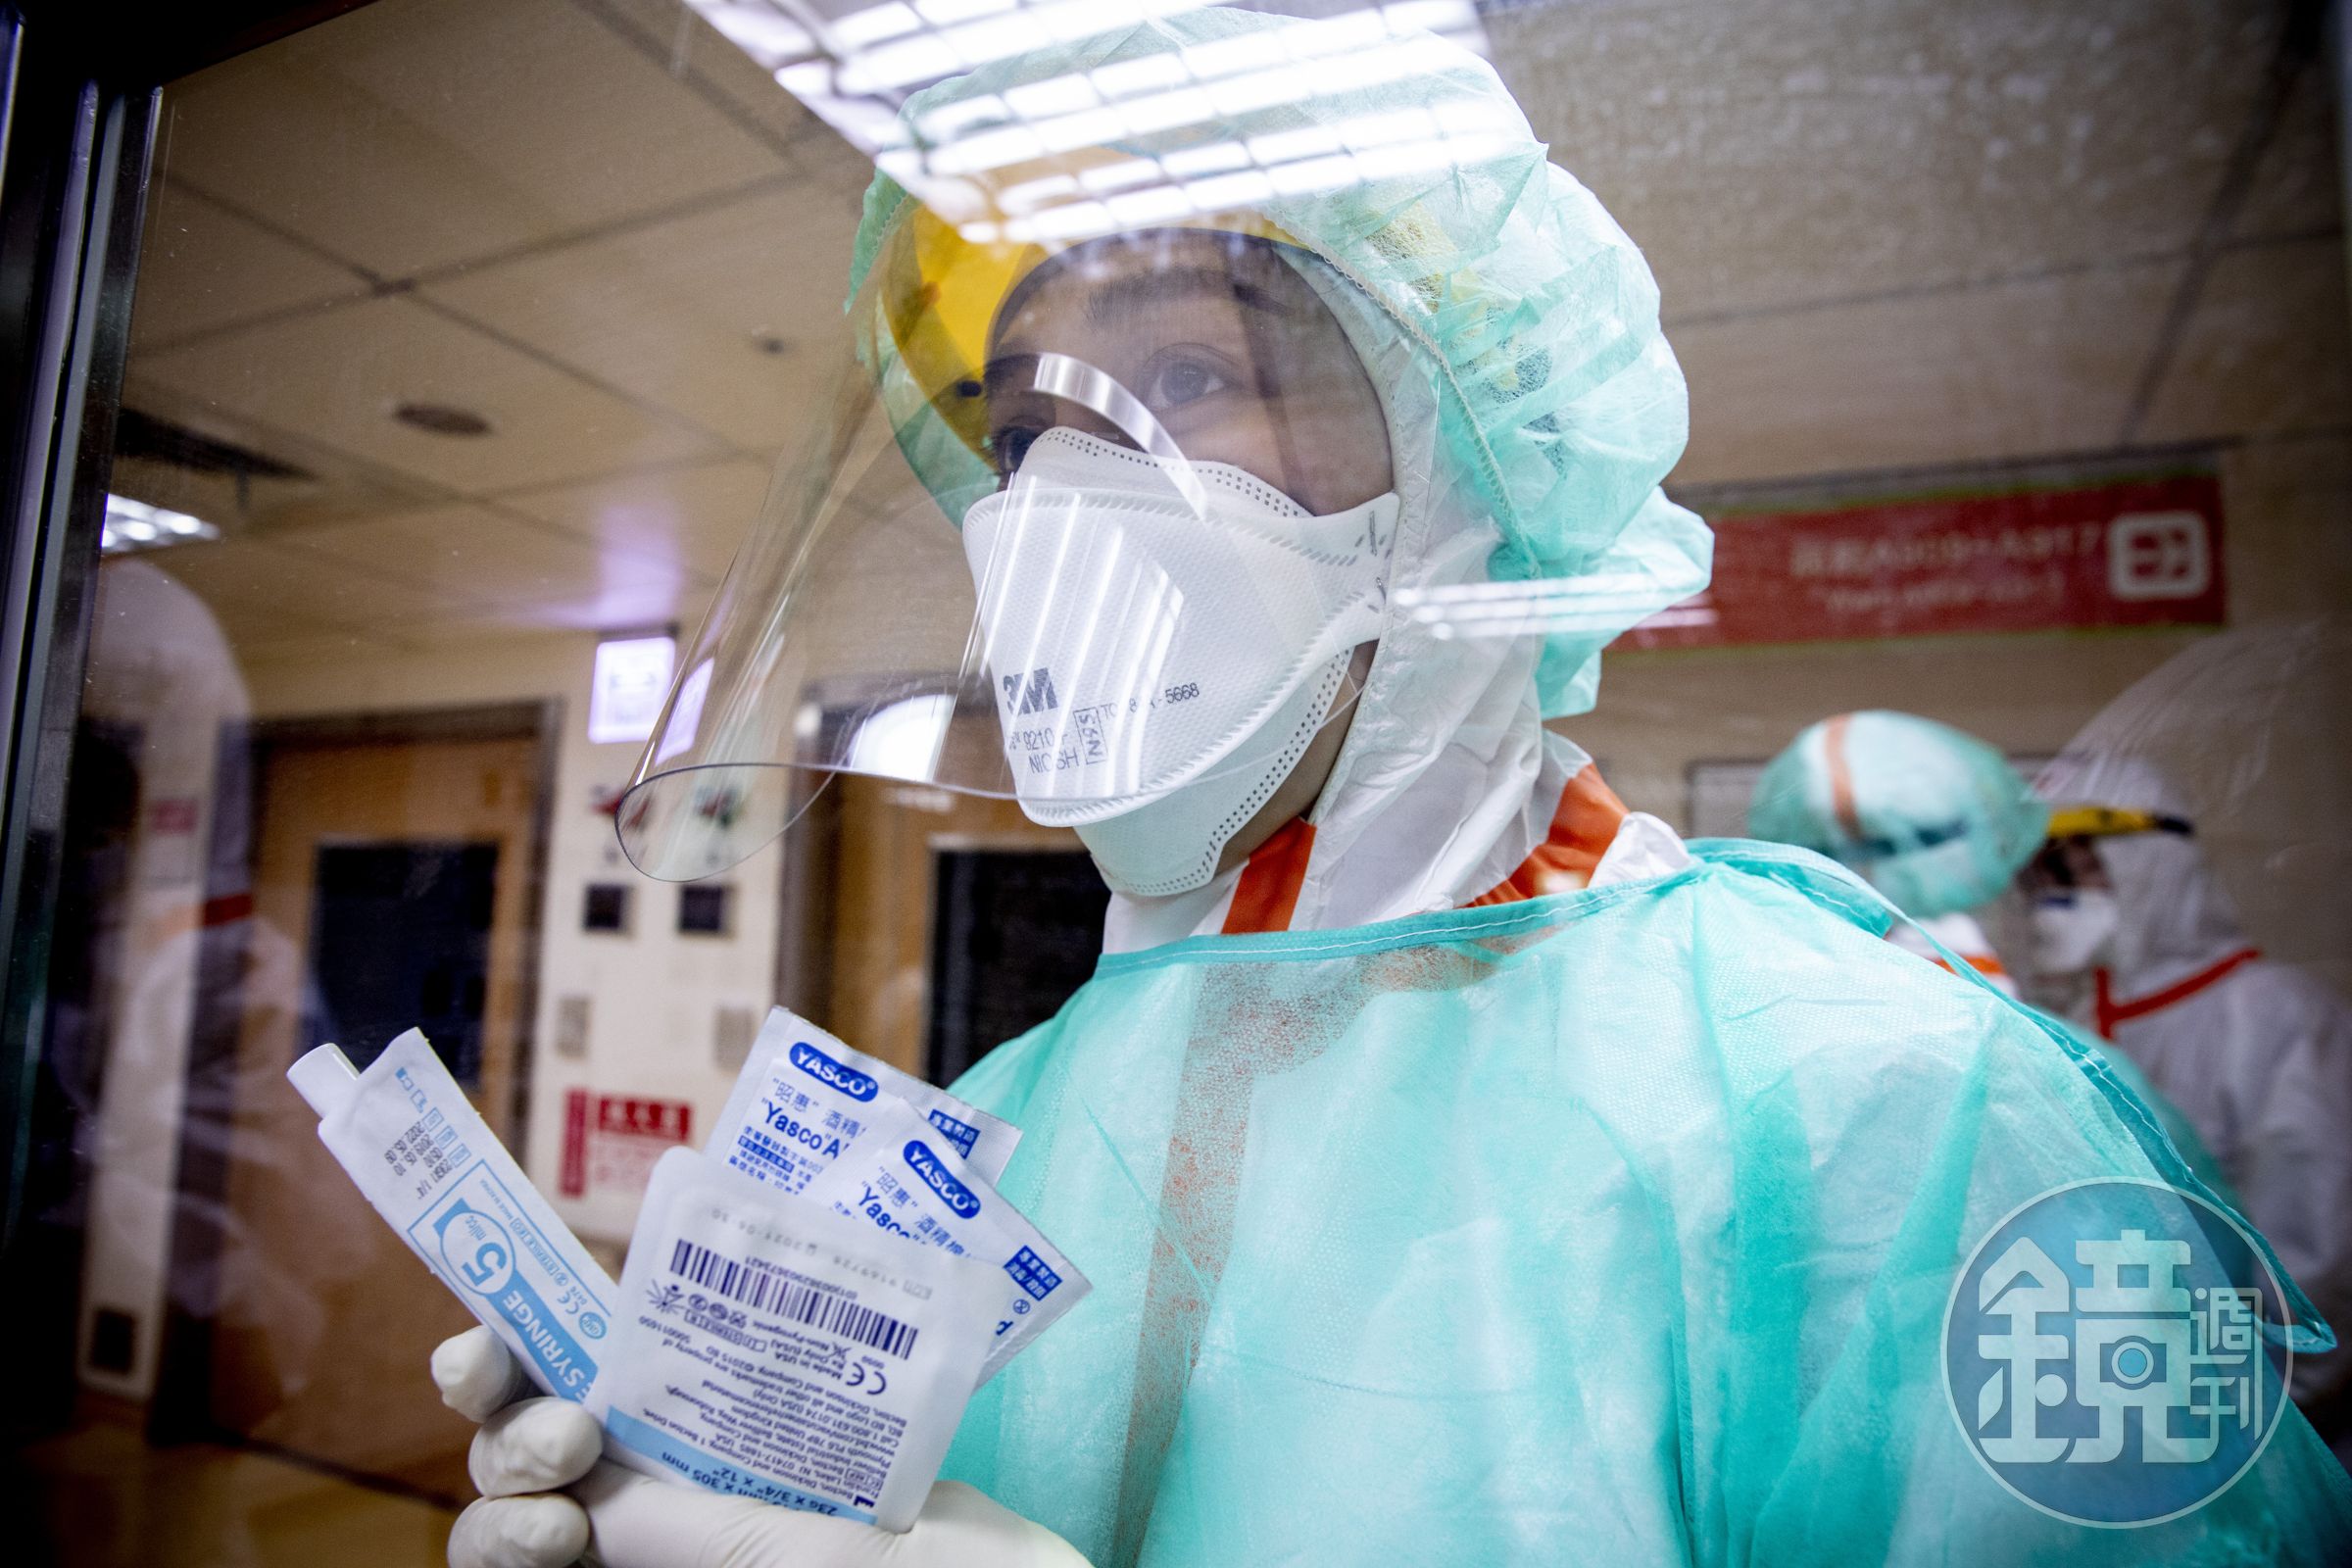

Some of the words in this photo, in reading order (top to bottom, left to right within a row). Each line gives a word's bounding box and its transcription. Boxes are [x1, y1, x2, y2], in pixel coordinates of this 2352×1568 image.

[1003, 666, 1058, 716] 3M
[1079, 714, 1104, 758] N95
[819, 1106, 868, 1143] 酒精
[458, 1236, 513, 1289] 5
[500, 1287, 586, 1390] SYRINGE
[773, 1348, 798, 1366] USA
[810, 1362, 842, 1381] Made
[783, 1386, 811, 1404] other
[803, 1381, 824, 1396] and
[823, 1389, 871, 1415] Dickinson
[823, 1401, 845, 1417] and
[729, 1402, 773, 1428] Kingdom
[712, 1432, 735, 1447] USA
[741, 1432, 761, 1446] and
[772, 1419, 806, 1440] United
[760, 1439, 808, 1464] Dickinson
[878, 1434, 900, 1448] Call
[659, 1450, 691, 1474] mm
[751, 1458, 771, 1474] and
[806, 1445, 852, 1467] Industrial
[845, 1446, 892, 1469] Plymouth
[690, 1467, 721, 1489] 305
[770, 1466, 817, 1490] Dickinson
